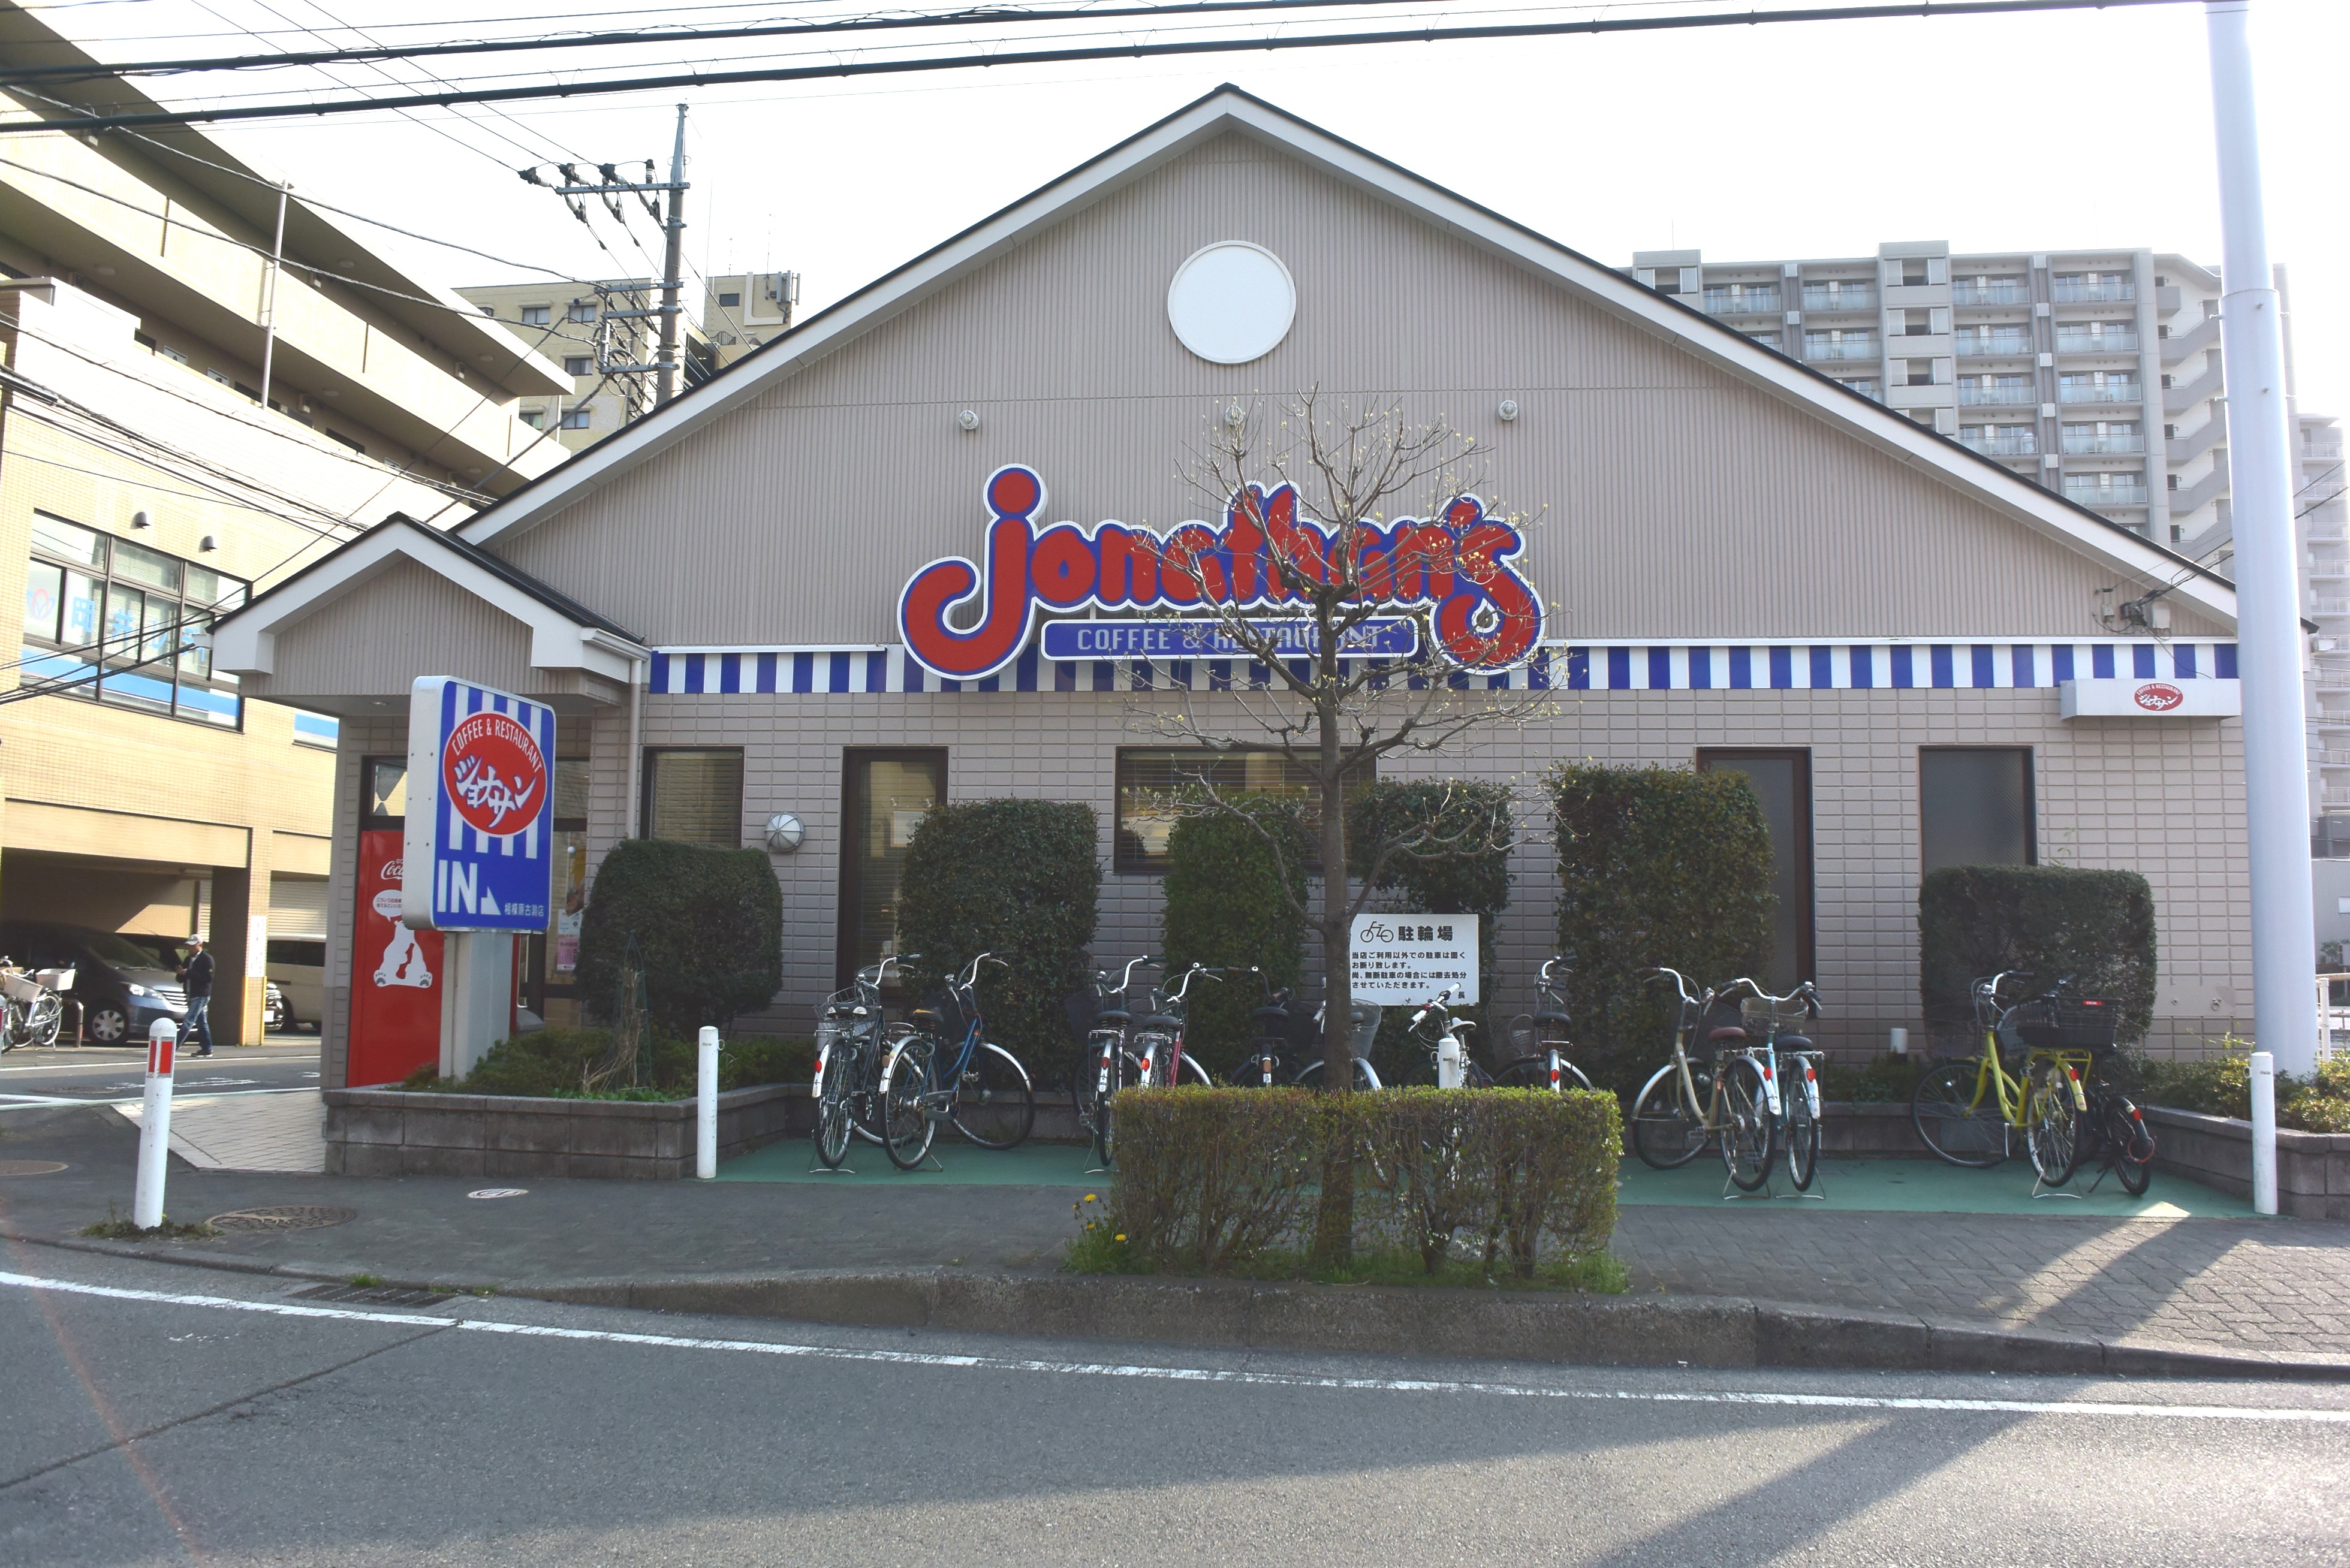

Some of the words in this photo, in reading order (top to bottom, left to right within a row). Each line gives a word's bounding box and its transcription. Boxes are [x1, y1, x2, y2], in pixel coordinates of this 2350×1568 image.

[1077, 628, 1171, 650] COFFEE
[1182, 630, 1200, 649] &
[1213, 626, 1382, 650] RTAUNT
[2136, 685, 2151, 695] COFFEE
[2138, 693, 2178, 710] ジョナサン
[451, 719, 483, 756] COFFEE
[486, 717, 492, 737] &
[495, 721, 543, 774] RESTAURANT
[453, 753, 537, 828] ジョナサン
[437, 859, 478, 914] IN
[1398, 925, 1453, 942] 駐輪場
